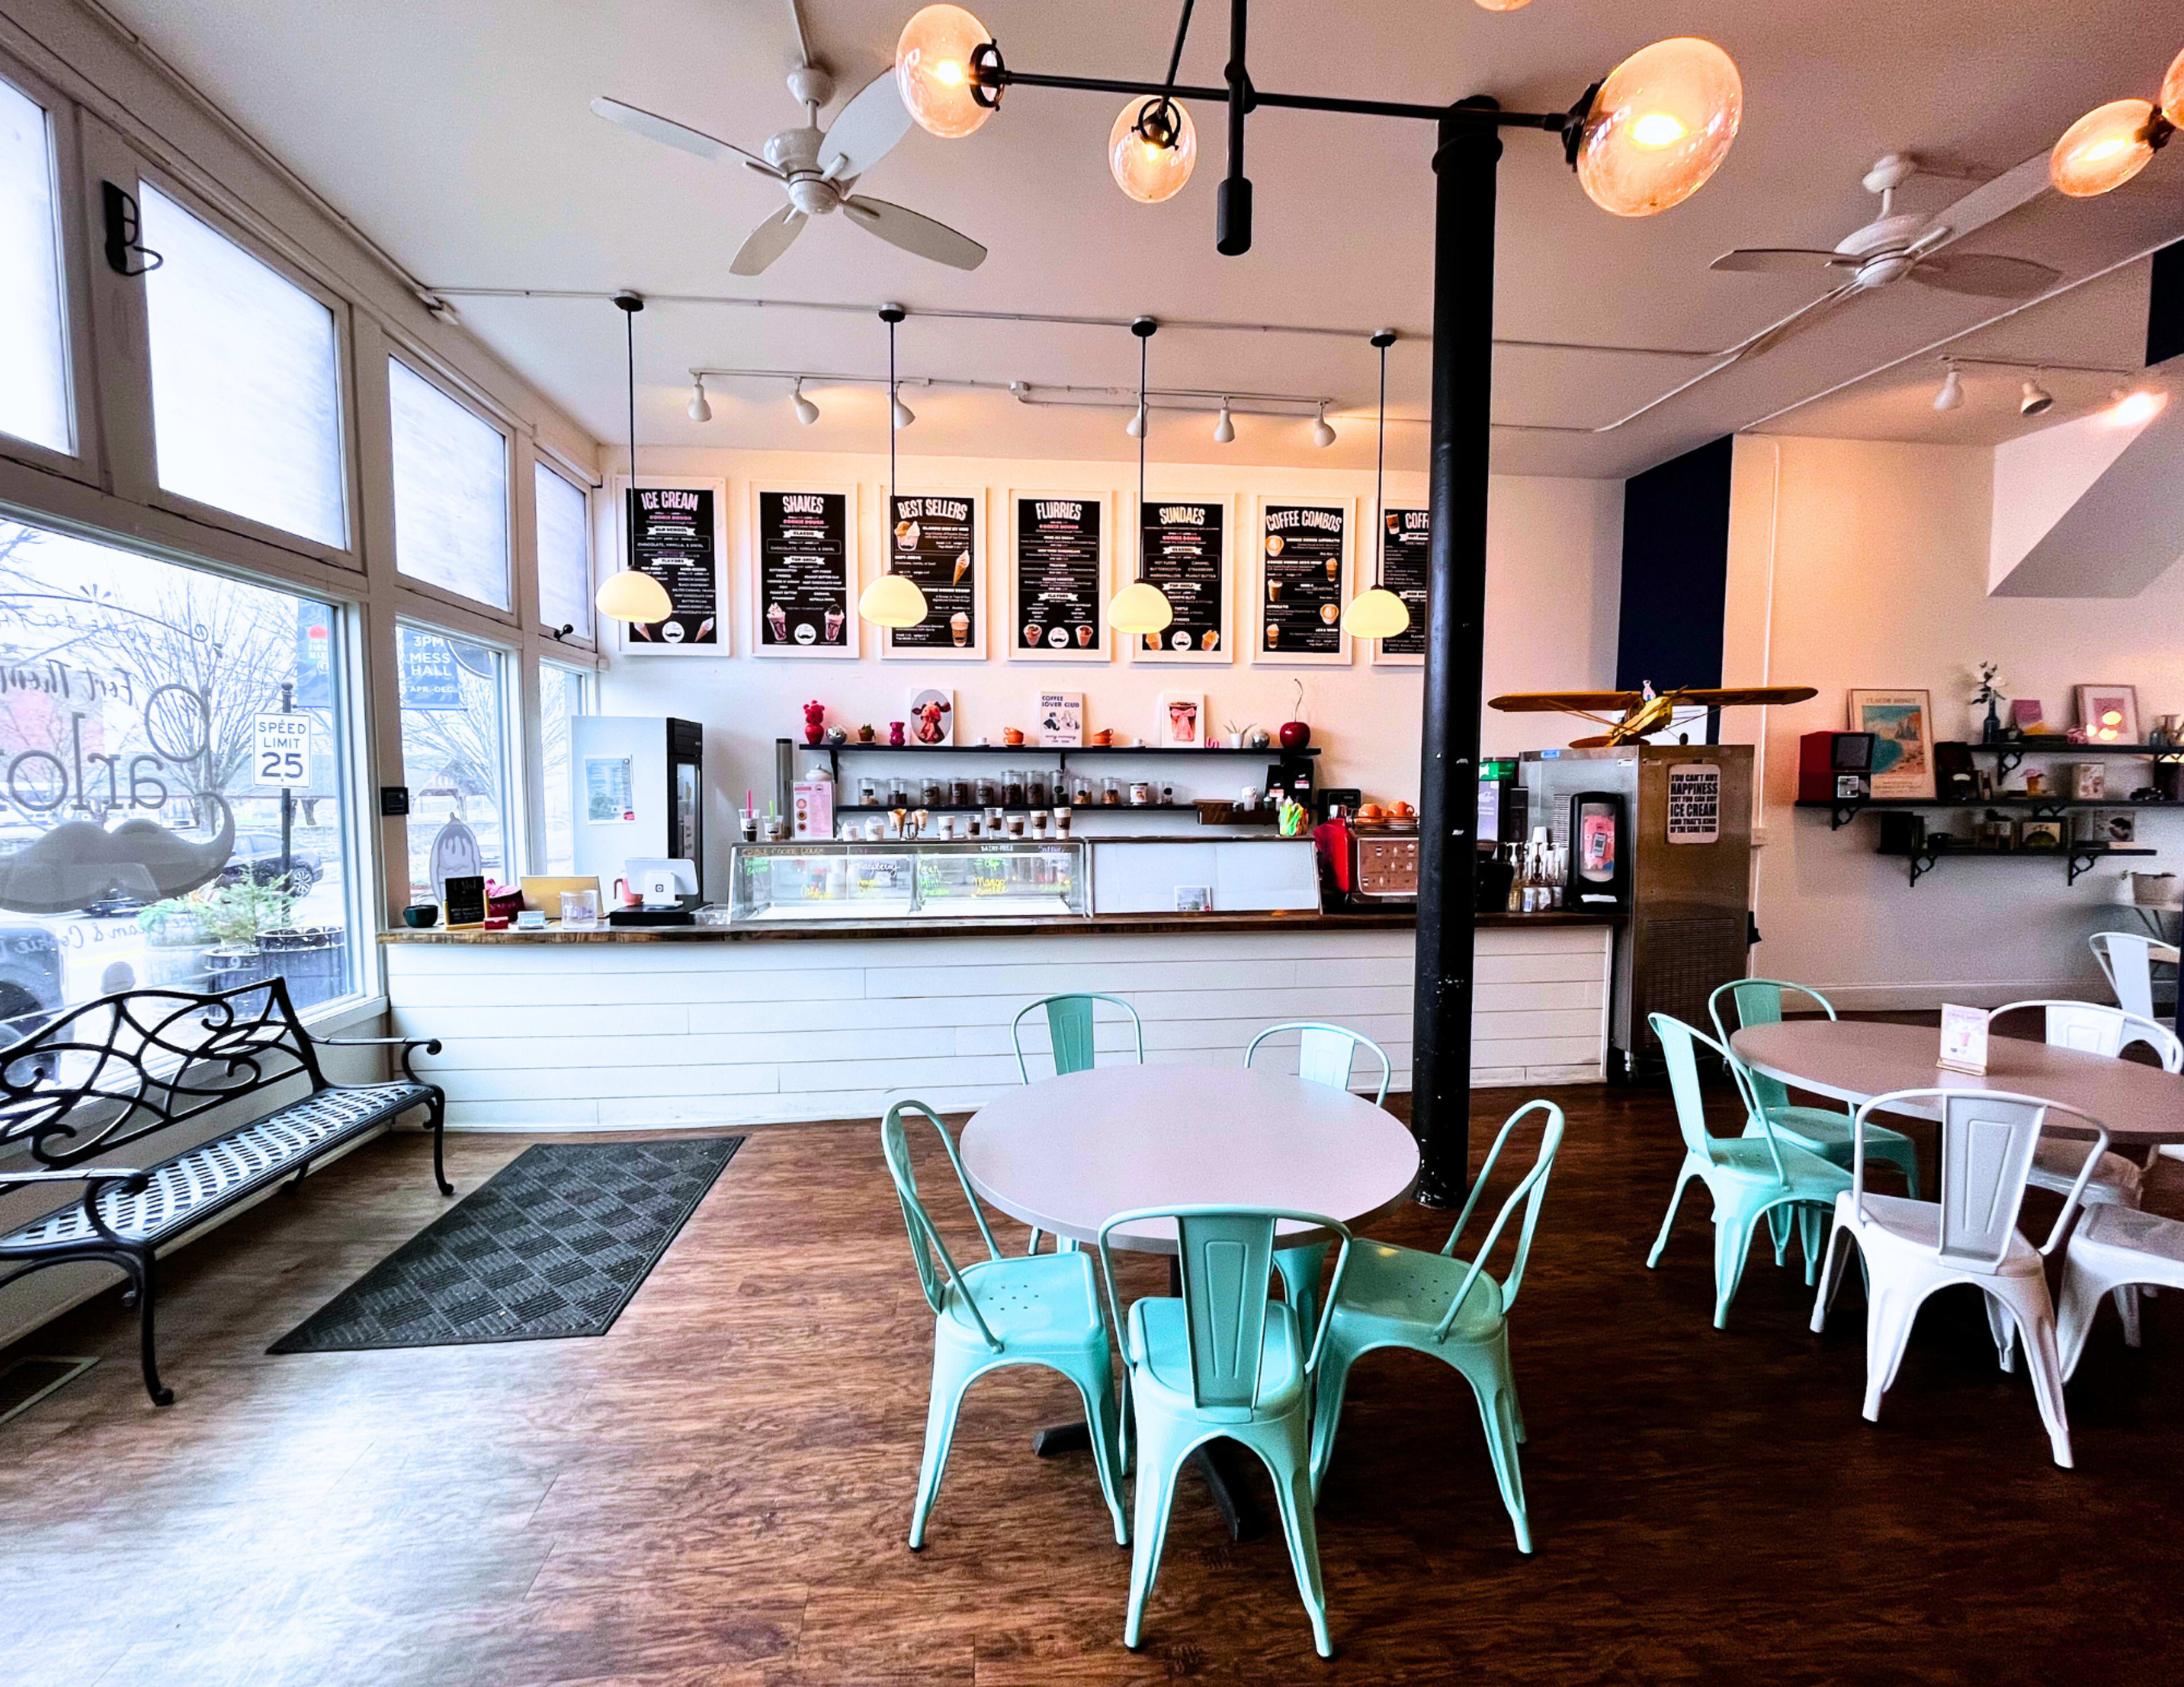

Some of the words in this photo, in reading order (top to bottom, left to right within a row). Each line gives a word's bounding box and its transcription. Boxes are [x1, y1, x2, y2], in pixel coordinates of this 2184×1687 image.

[641, 491, 660, 510] ICE
[661, 491, 699, 511] CREAM
[783, 495, 824, 514] SHAKES
[897, 499, 923, 519] BEST
[925, 499, 967, 521] SELLERS
[1035, 502, 1082, 521] FLURRIES
[1159, 506, 1205, 526] SUNDAES
[1266, 510, 1300, 531] COFFEE
[1301, 510, 1342, 532] COMBOS
[413, 636, 444, 647] 3PM
[410, 652, 451, 664] MESS
[411, 666, 452, 677] HALL
[259, 722, 307, 734] SPEED
[264, 738, 300, 749] LIMIT
[262, 752, 303, 778] 25
[1670, 783, 1718, 795] HAPPINESS
[1670, 803, 1685, 817] ICE
[1686, 803, 1717, 817] CREAM
